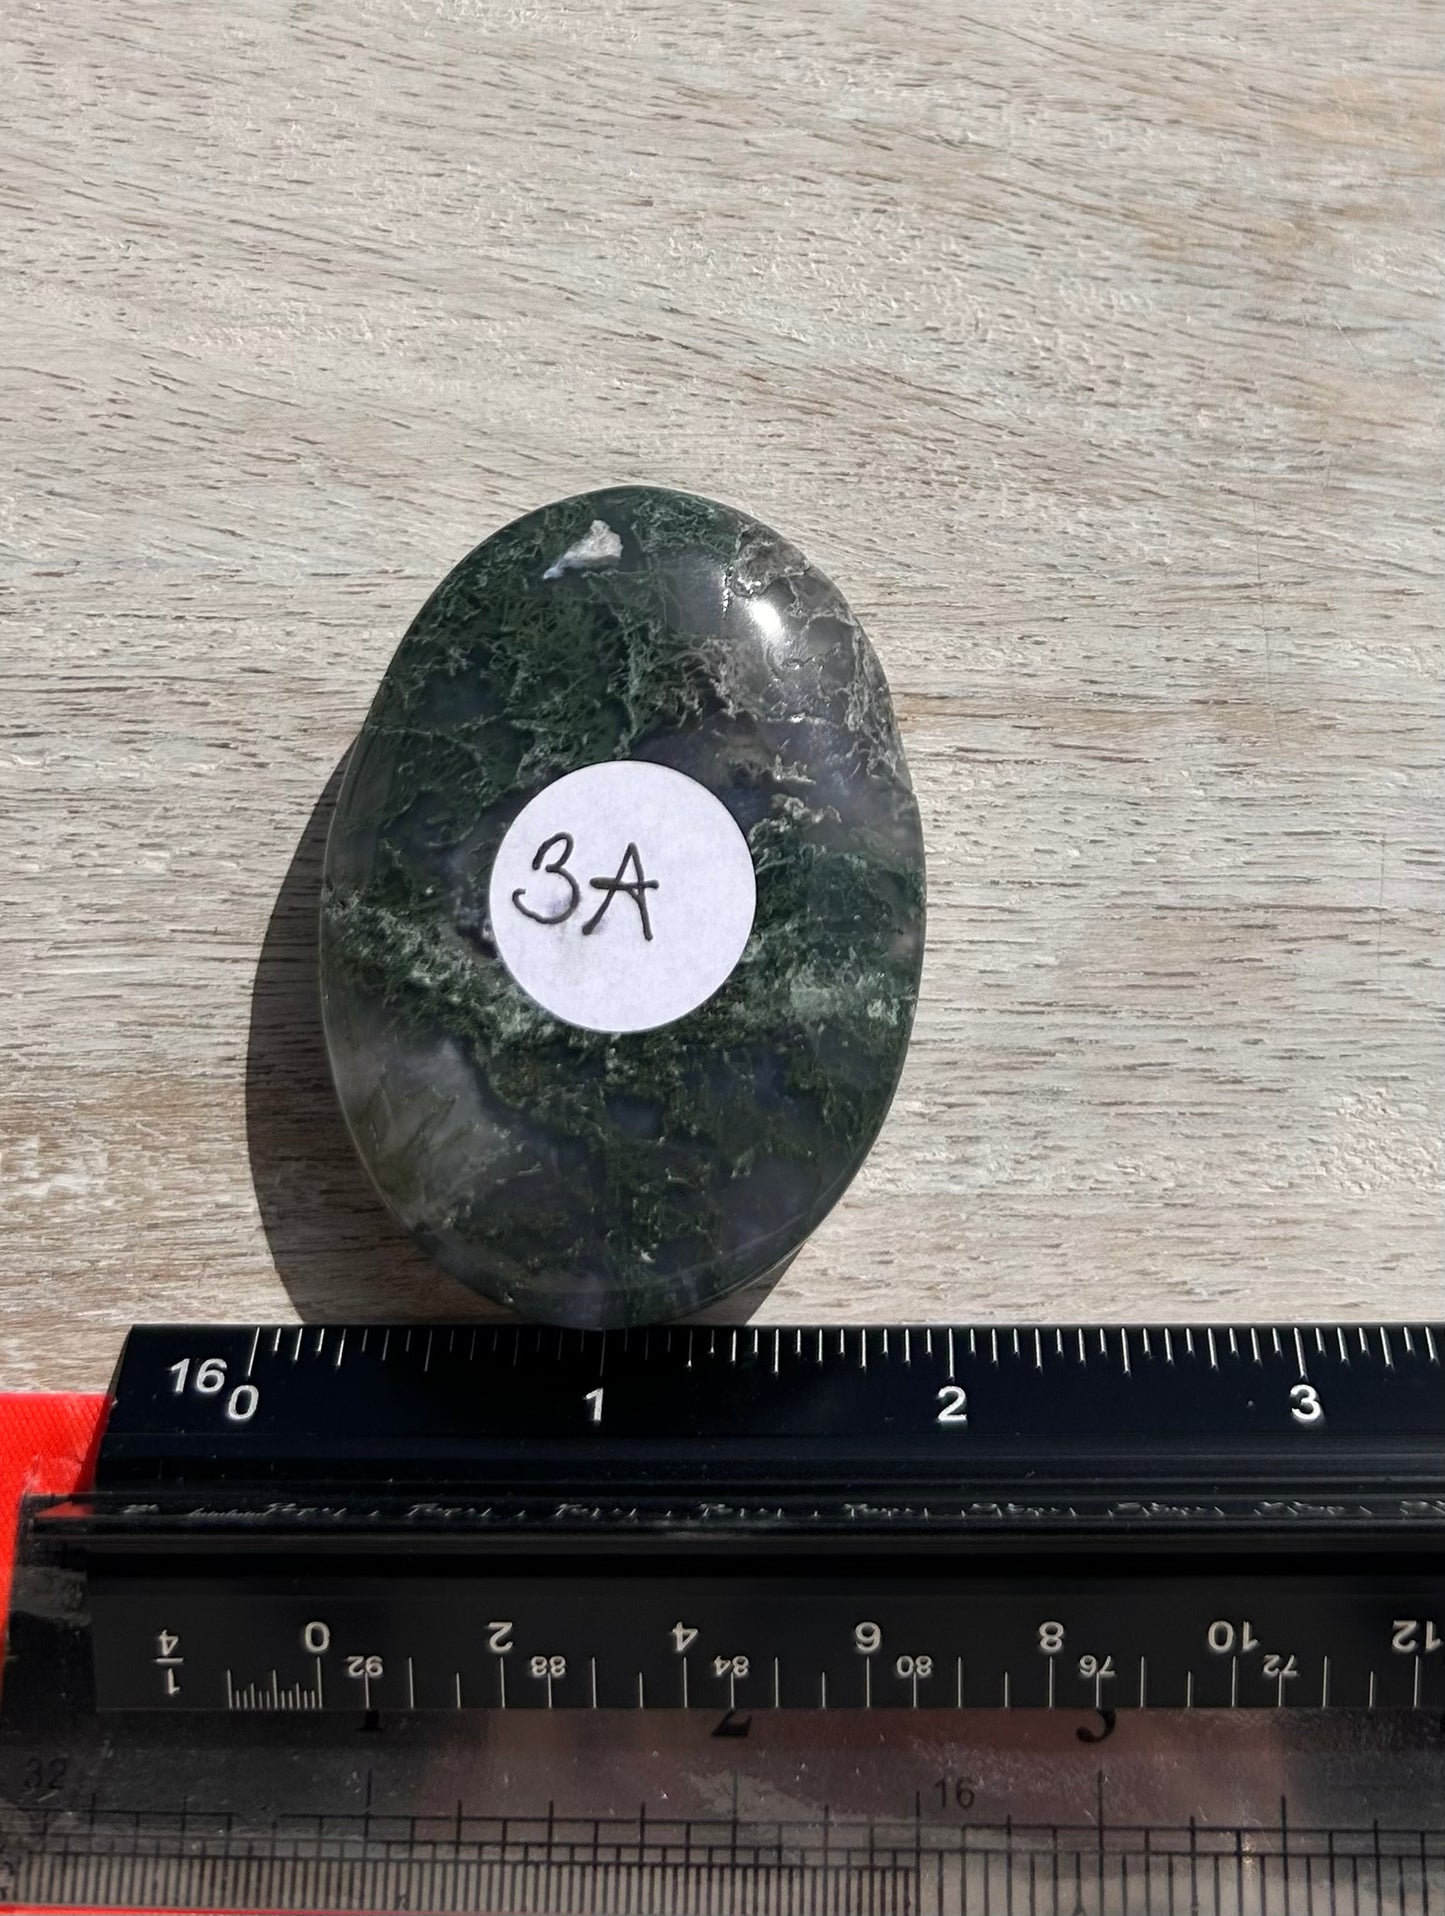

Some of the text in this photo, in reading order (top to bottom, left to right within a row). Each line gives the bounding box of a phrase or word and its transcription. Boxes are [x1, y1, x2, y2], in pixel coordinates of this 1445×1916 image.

[512, 831, 660, 941] 3A
[169, 1357, 228, 1394] 16
[227, 1383, 1323, 1423] 0 1 2 3
[304, 1620, 1442, 1654] 0 2 4 6 8 10 12
[347, 1654, 1299, 1677] 92 88 84 80 76 72
[23, 1757, 69, 1791] 32
[933, 1775, 977, 1809] 16
